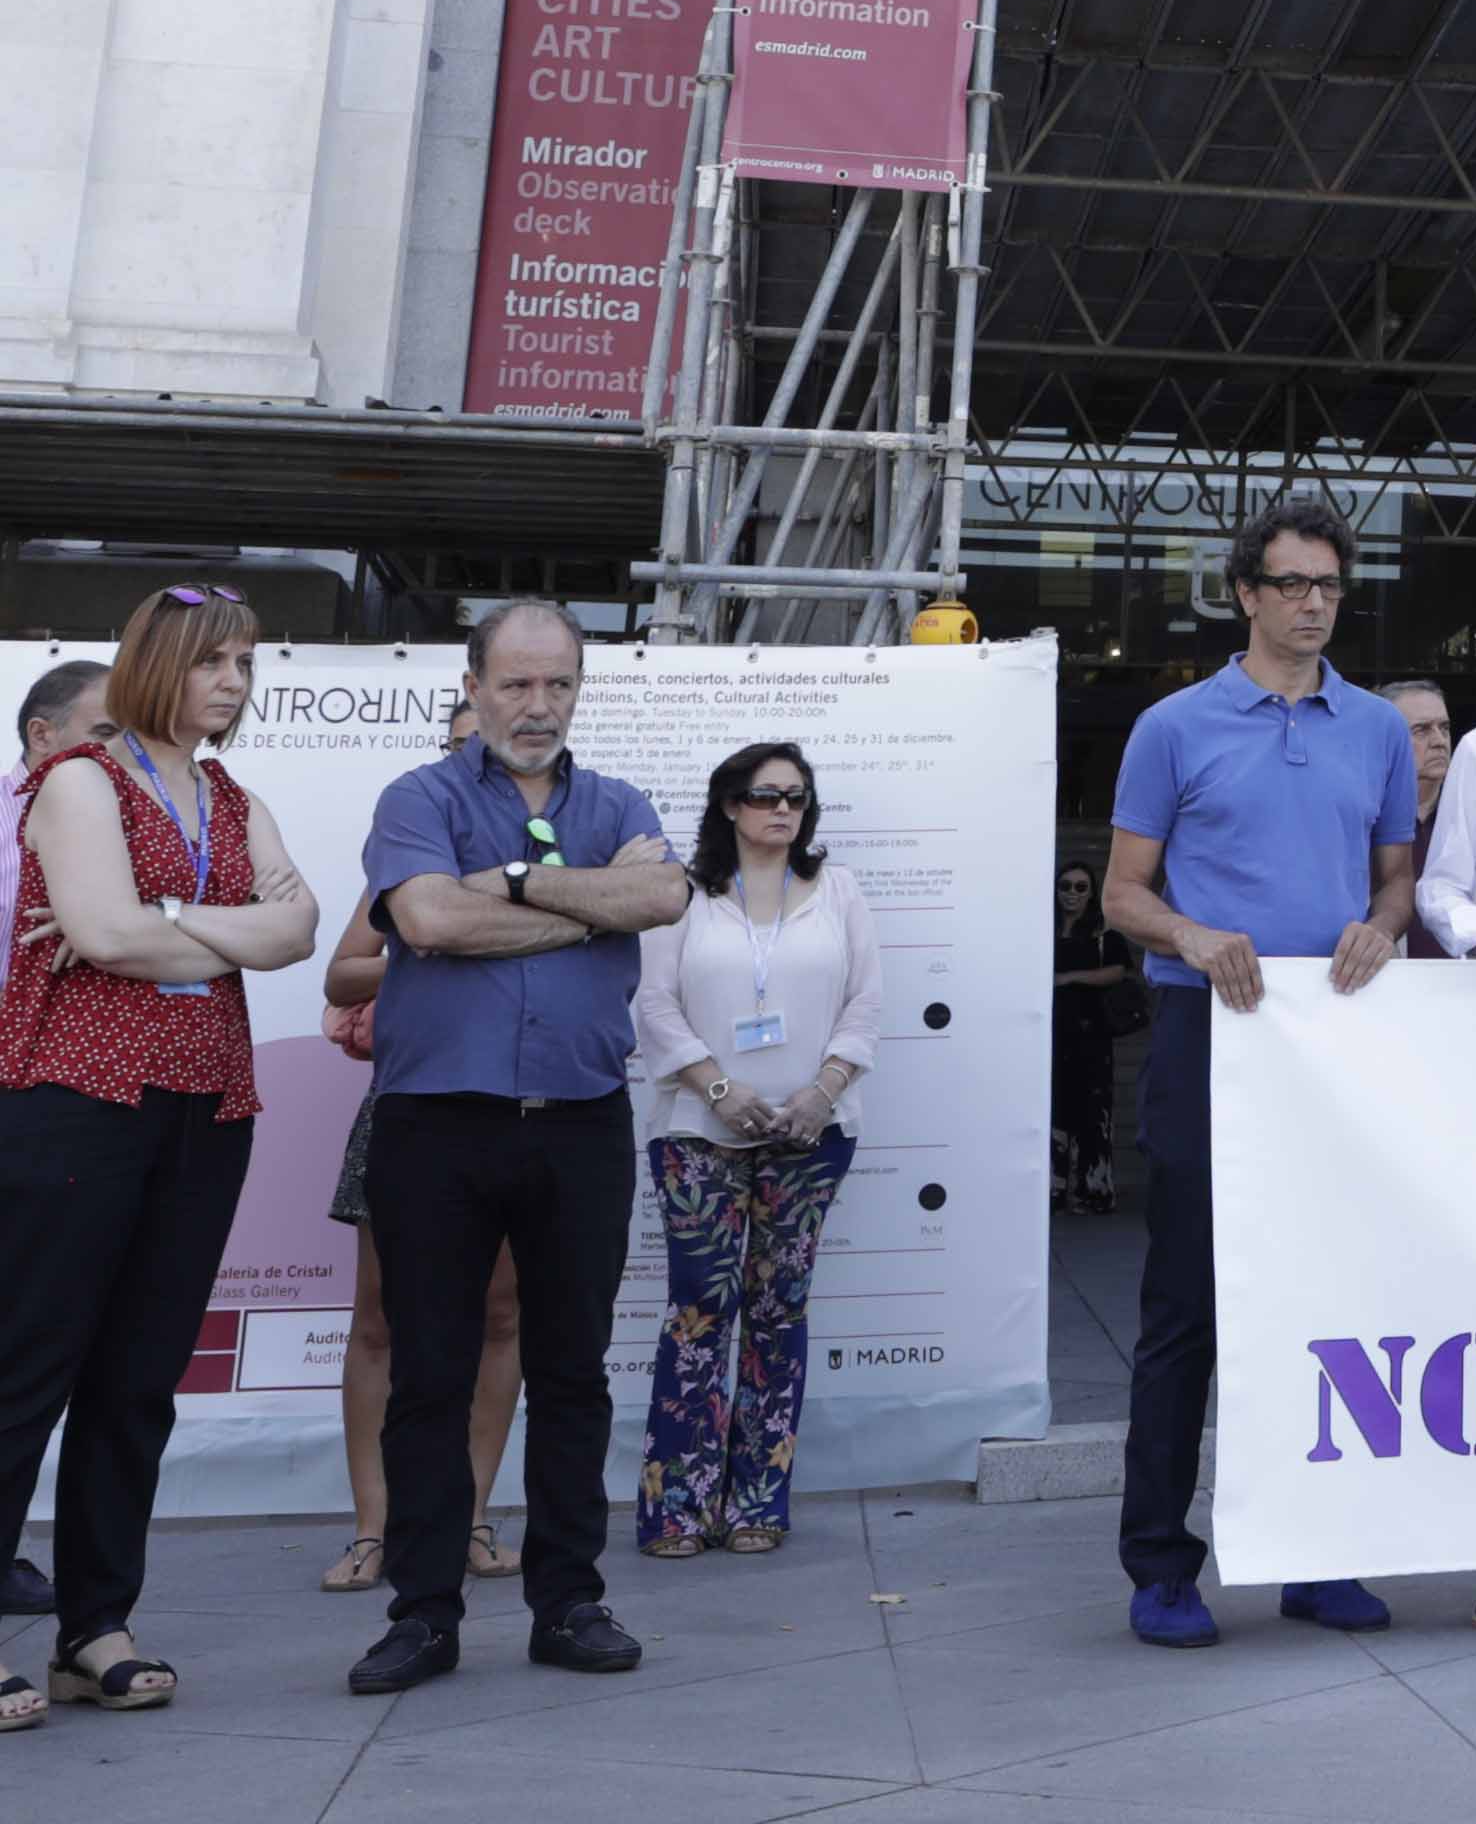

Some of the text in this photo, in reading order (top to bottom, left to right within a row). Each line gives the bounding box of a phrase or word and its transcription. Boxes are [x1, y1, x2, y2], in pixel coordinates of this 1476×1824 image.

[532, 23, 621, 61] ART
[755, 40, 867, 61] esmadrid.com
[521, 136, 648, 168] Mirador
[892, 166, 955, 182] MADRID
[517, 170, 679, 205] Observati
[513, 207, 592, 236] deck
[505, 289, 641, 321] turística
[502, 324, 615, 355] Tourist
[581, 672, 652, 687] osiciones,
[739, 672, 817, 685] actividades
[821, 672, 890, 685] culturales
[715, 691, 770, 704] Cultural
[775, 690, 839, 704] Activities
[254, 734, 276, 749] DE
[281, 734, 363, 749] CULTURA
[363, 734, 377, 749] Y
[264, 1266, 282, 1279] de
[287, 1264, 333, 1277] Cristal
[251, 1284, 302, 1301] Gallery
[857, 1347, 944, 1366] MADRID
